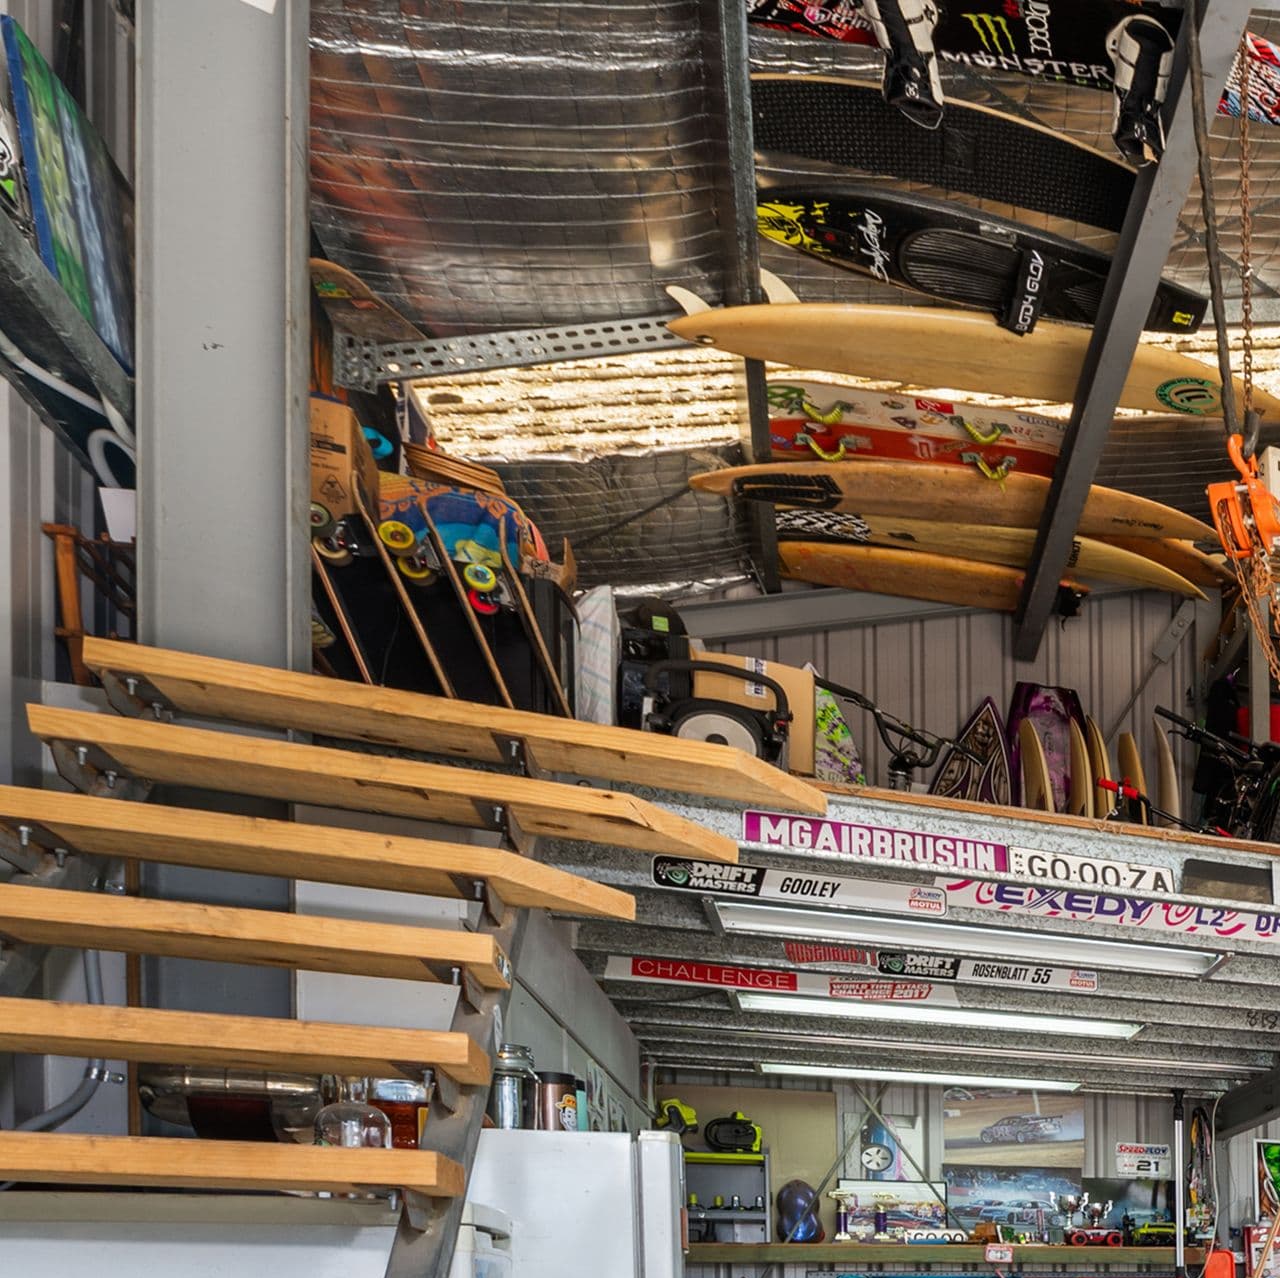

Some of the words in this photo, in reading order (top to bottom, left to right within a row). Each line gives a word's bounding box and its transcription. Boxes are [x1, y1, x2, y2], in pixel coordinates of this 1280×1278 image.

[759, 815, 997, 872] MGAIRBRUSHN
[688, 876, 758, 895] MASTERS
[692, 860, 758, 881] DRIFT
[779, 876, 841, 899] GOOLEY
[909, 901, 942, 911] MOTUL
[994, 881, 1158, 919] EXEDY
[637, 959, 791, 989] CHALLENGE
[904, 966, 954, 977] MASTERS
[905, 954, 954, 968] DRIFT
[972, 963, 1029, 982] ROSENBLATT
[1031, 967, 1053, 985] 55
[893, 989, 929, 999] 2017
[1136, 1160, 1160, 1172] 21
